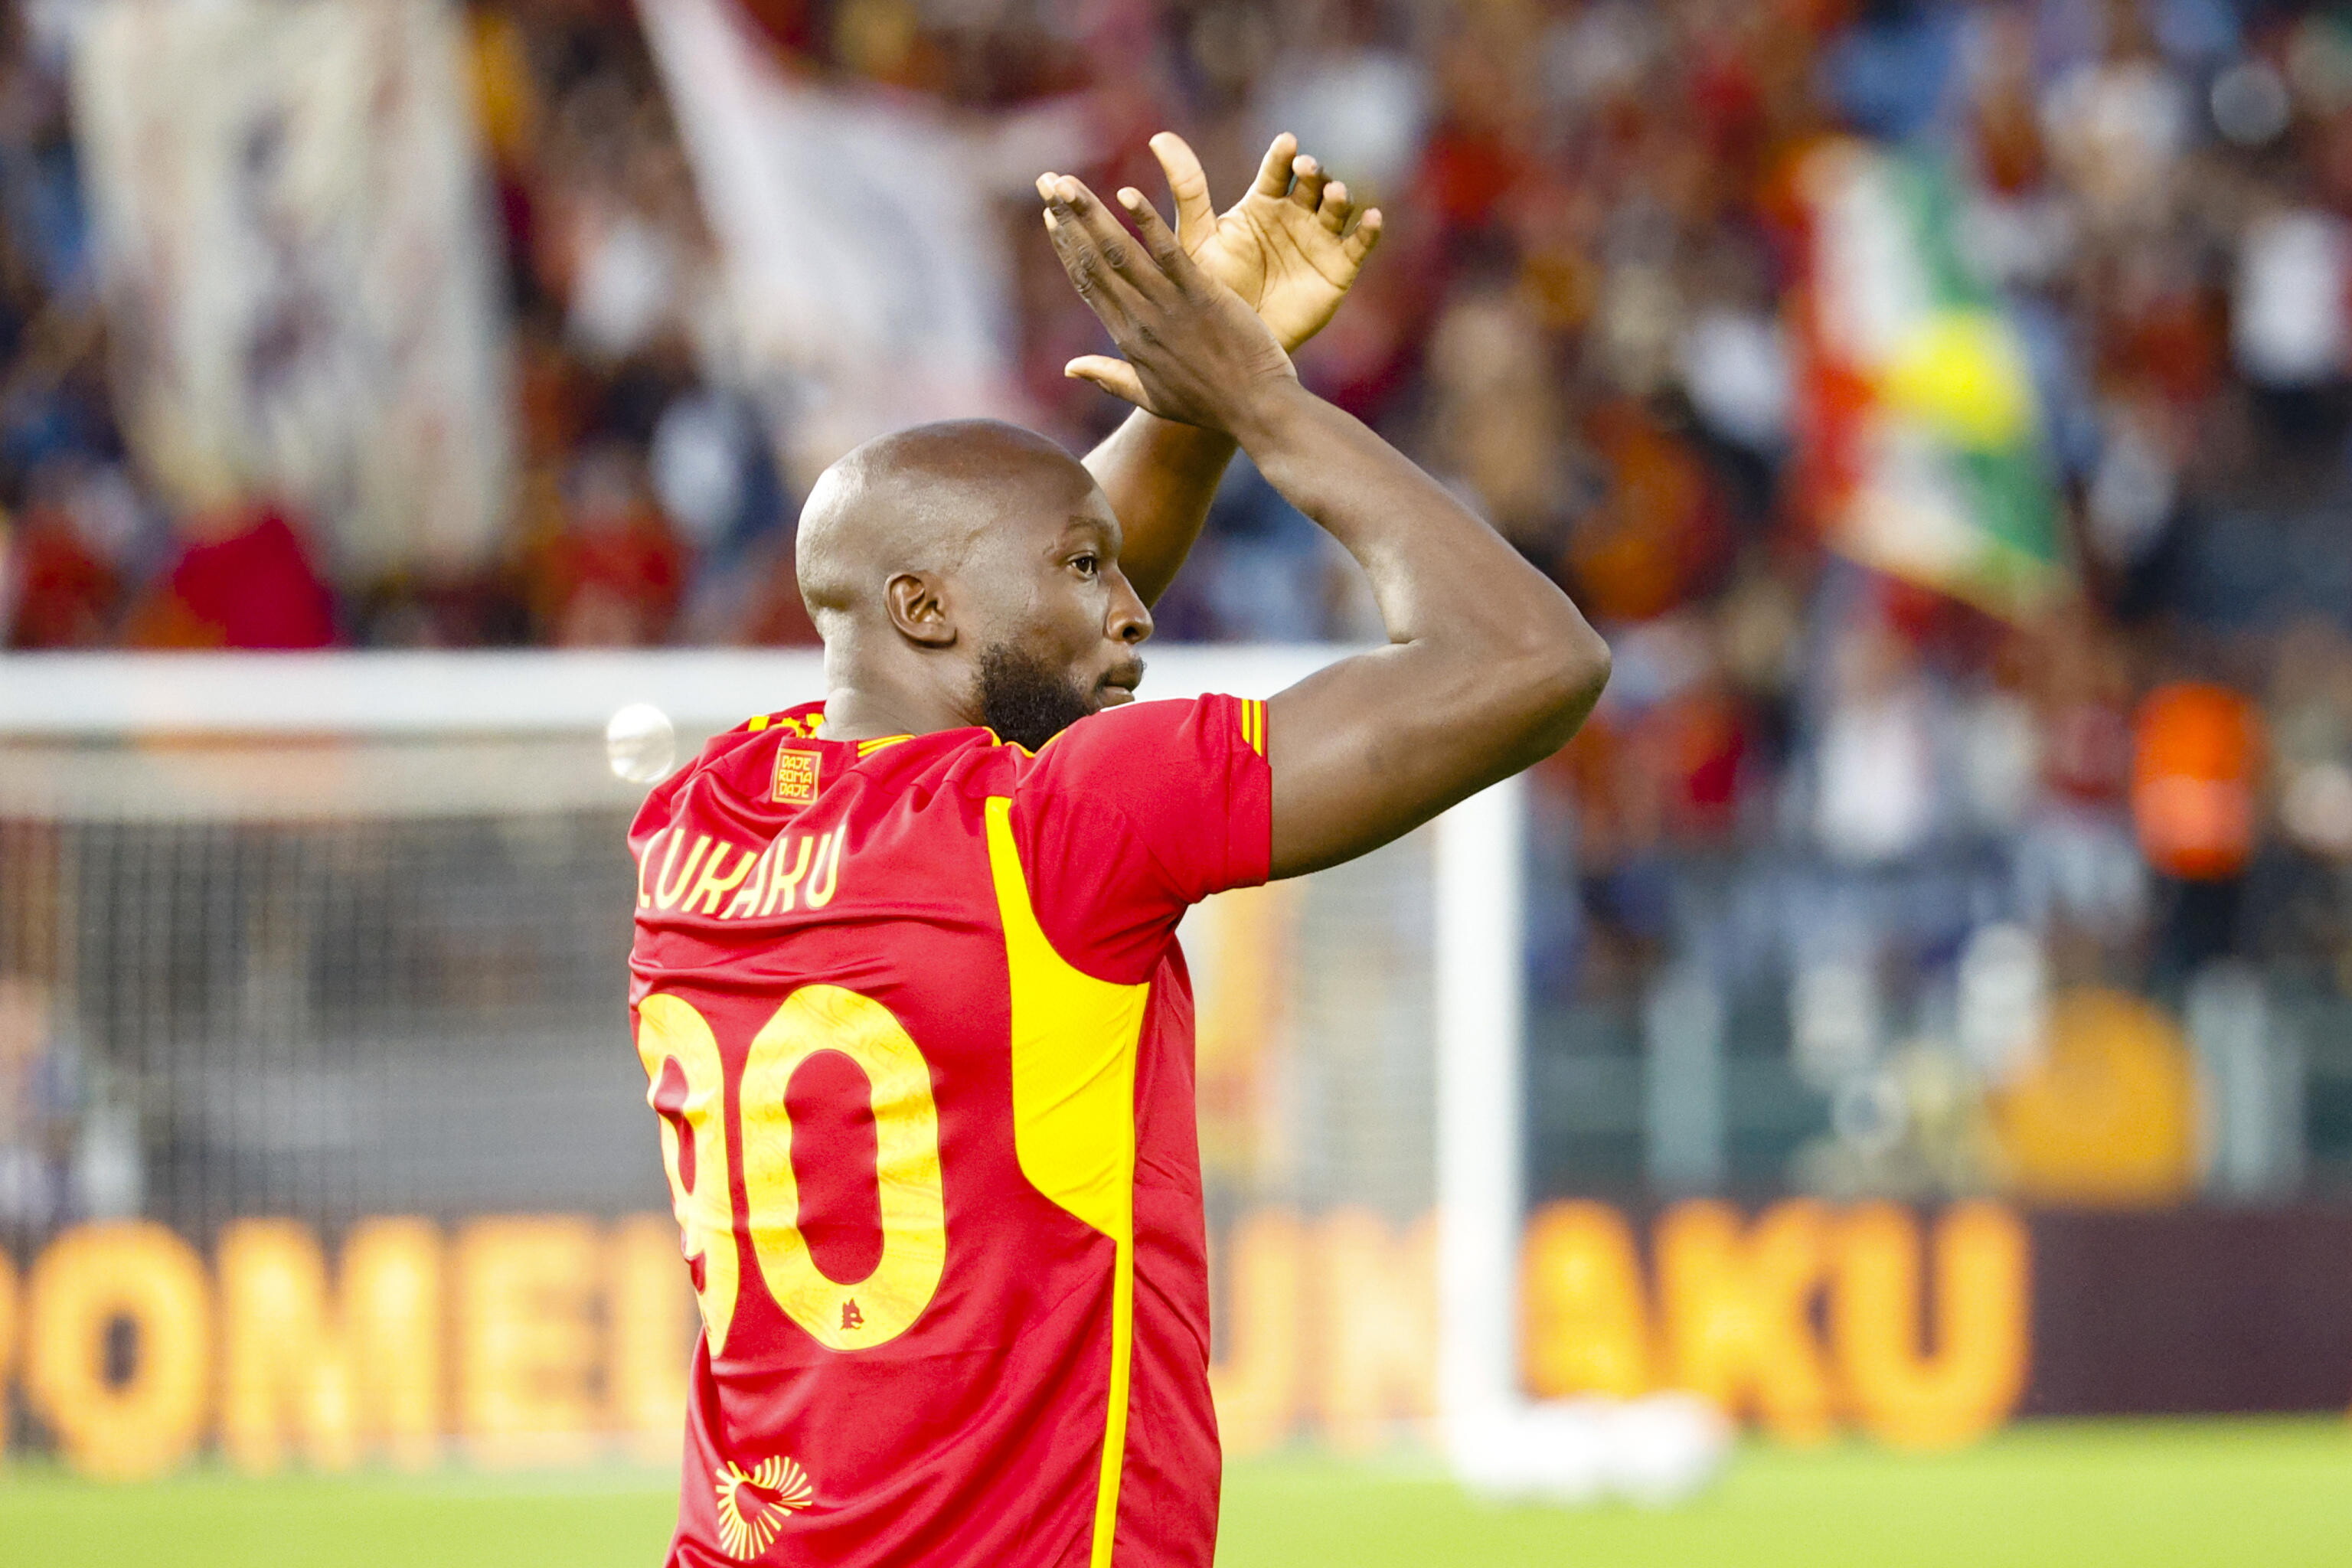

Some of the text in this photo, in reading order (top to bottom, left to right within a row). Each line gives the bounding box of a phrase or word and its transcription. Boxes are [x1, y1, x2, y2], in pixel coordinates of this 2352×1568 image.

[781, 755, 812, 770] DAJE
[778, 769, 812, 784] ROMA
[779, 782, 809, 798] DAJE
[638, 824, 848, 920] LUKAKU
[637, 983, 947, 1358] 90
